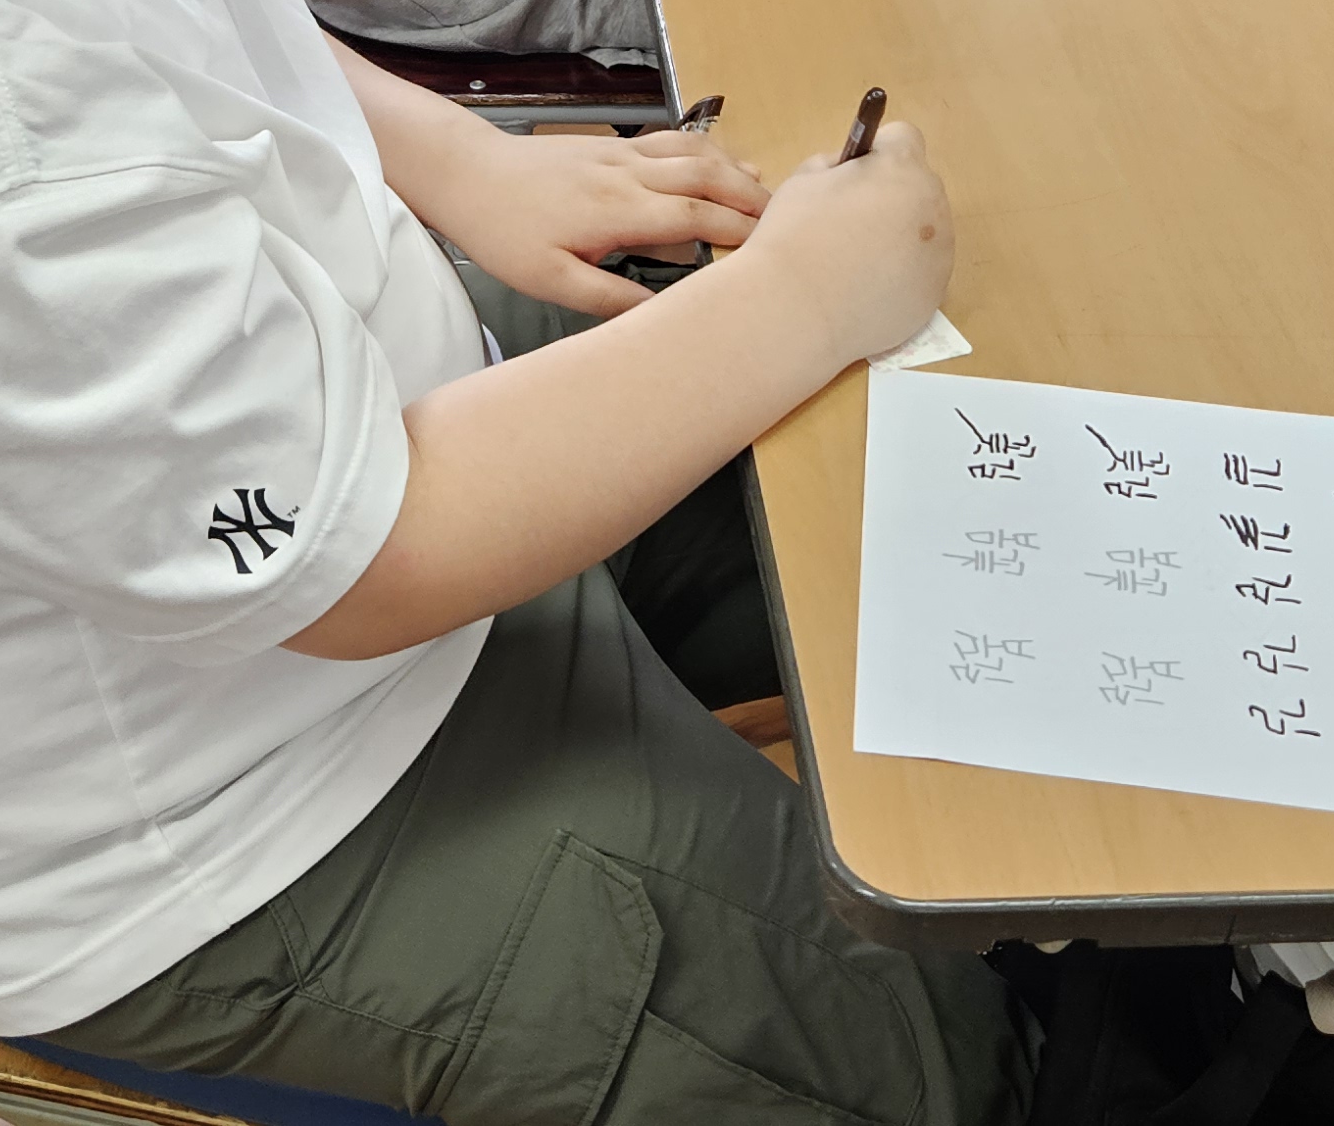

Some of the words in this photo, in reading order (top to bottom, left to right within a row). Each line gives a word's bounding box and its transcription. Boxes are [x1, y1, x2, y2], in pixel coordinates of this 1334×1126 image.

[954, 407, 1037, 481] 꽃길
[1085, 424, 1170, 499] 꽃길
[1224, 453, 1283, 491] 길
[942, 529, 1041, 576] 봄꽃
[1084, 547, 1183, 597] 봄꽃
[1235, 574, 1302, 605] 길
[949, 630, 1036, 684] 봄길
[1098, 651, 1185, 706] 봄길
[1243, 635, 1309, 675] 길
[1248, 699, 1321, 737] 길
